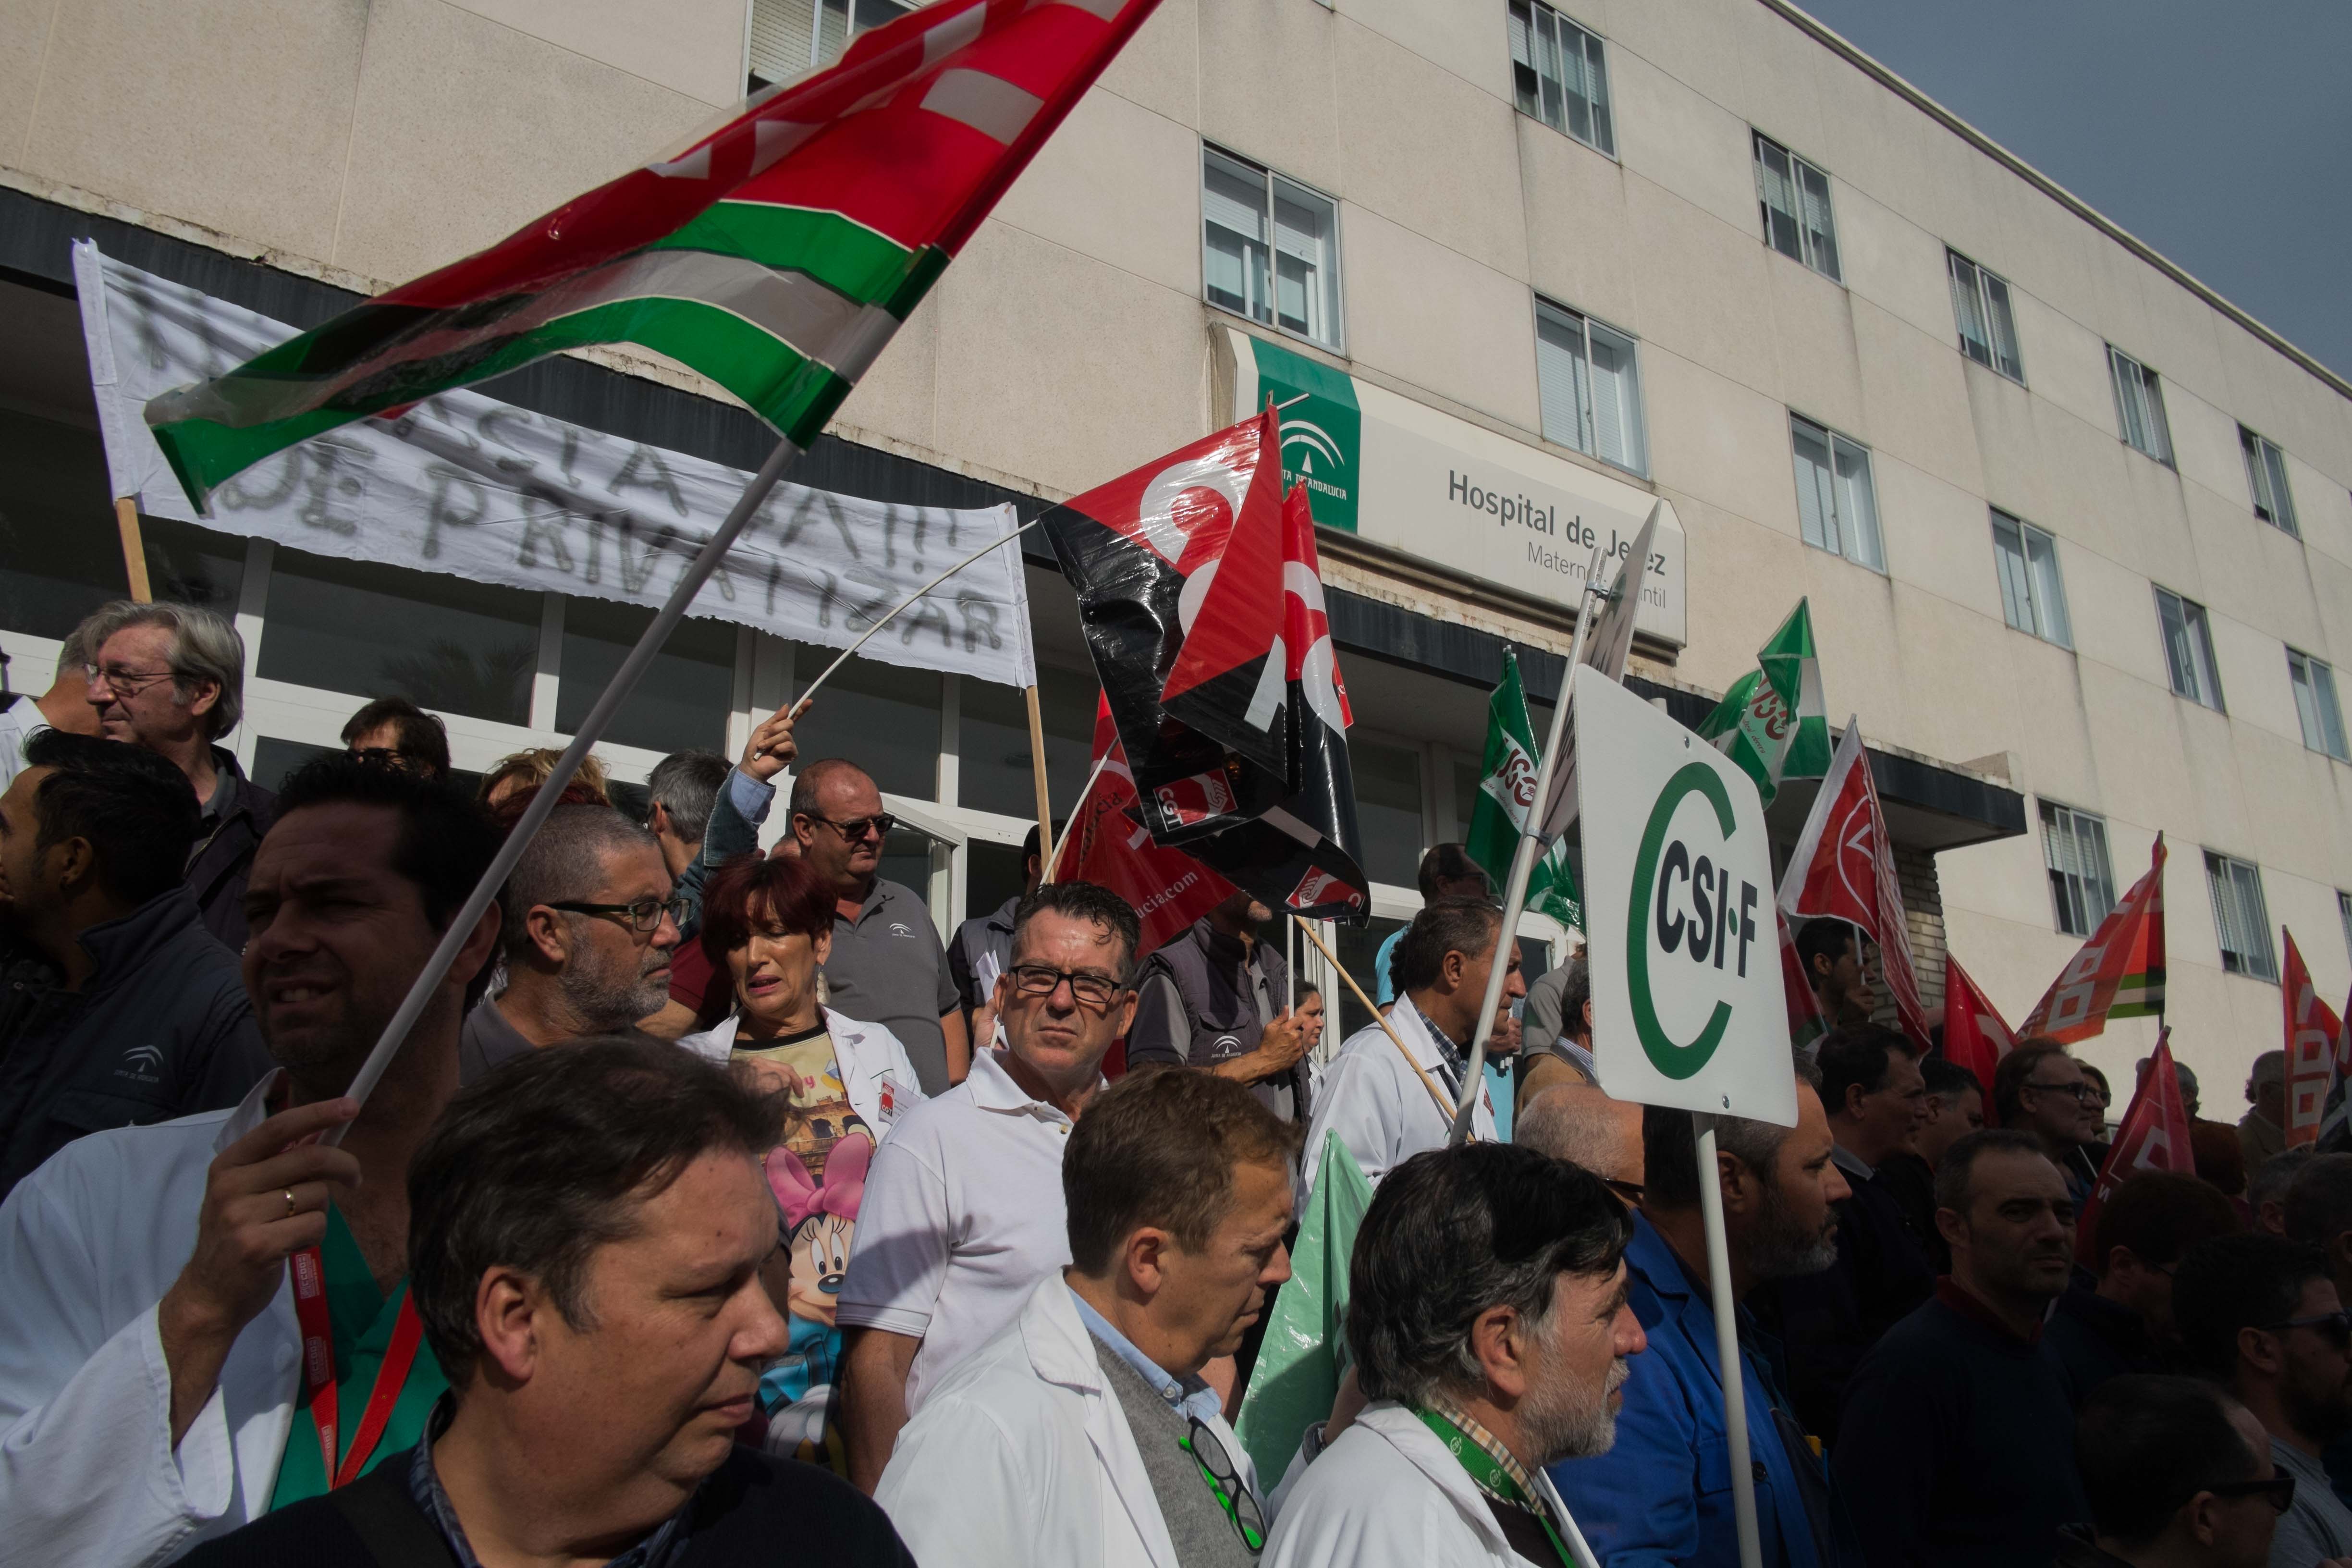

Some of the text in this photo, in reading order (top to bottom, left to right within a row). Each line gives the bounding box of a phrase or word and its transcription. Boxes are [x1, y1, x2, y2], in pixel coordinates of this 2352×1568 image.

[1449, 469, 1555, 536] Hospital
[1566, 514, 1595, 550] de
[1158, 787, 1184, 826] CGT
[881, 1104, 893, 1115] CGT
